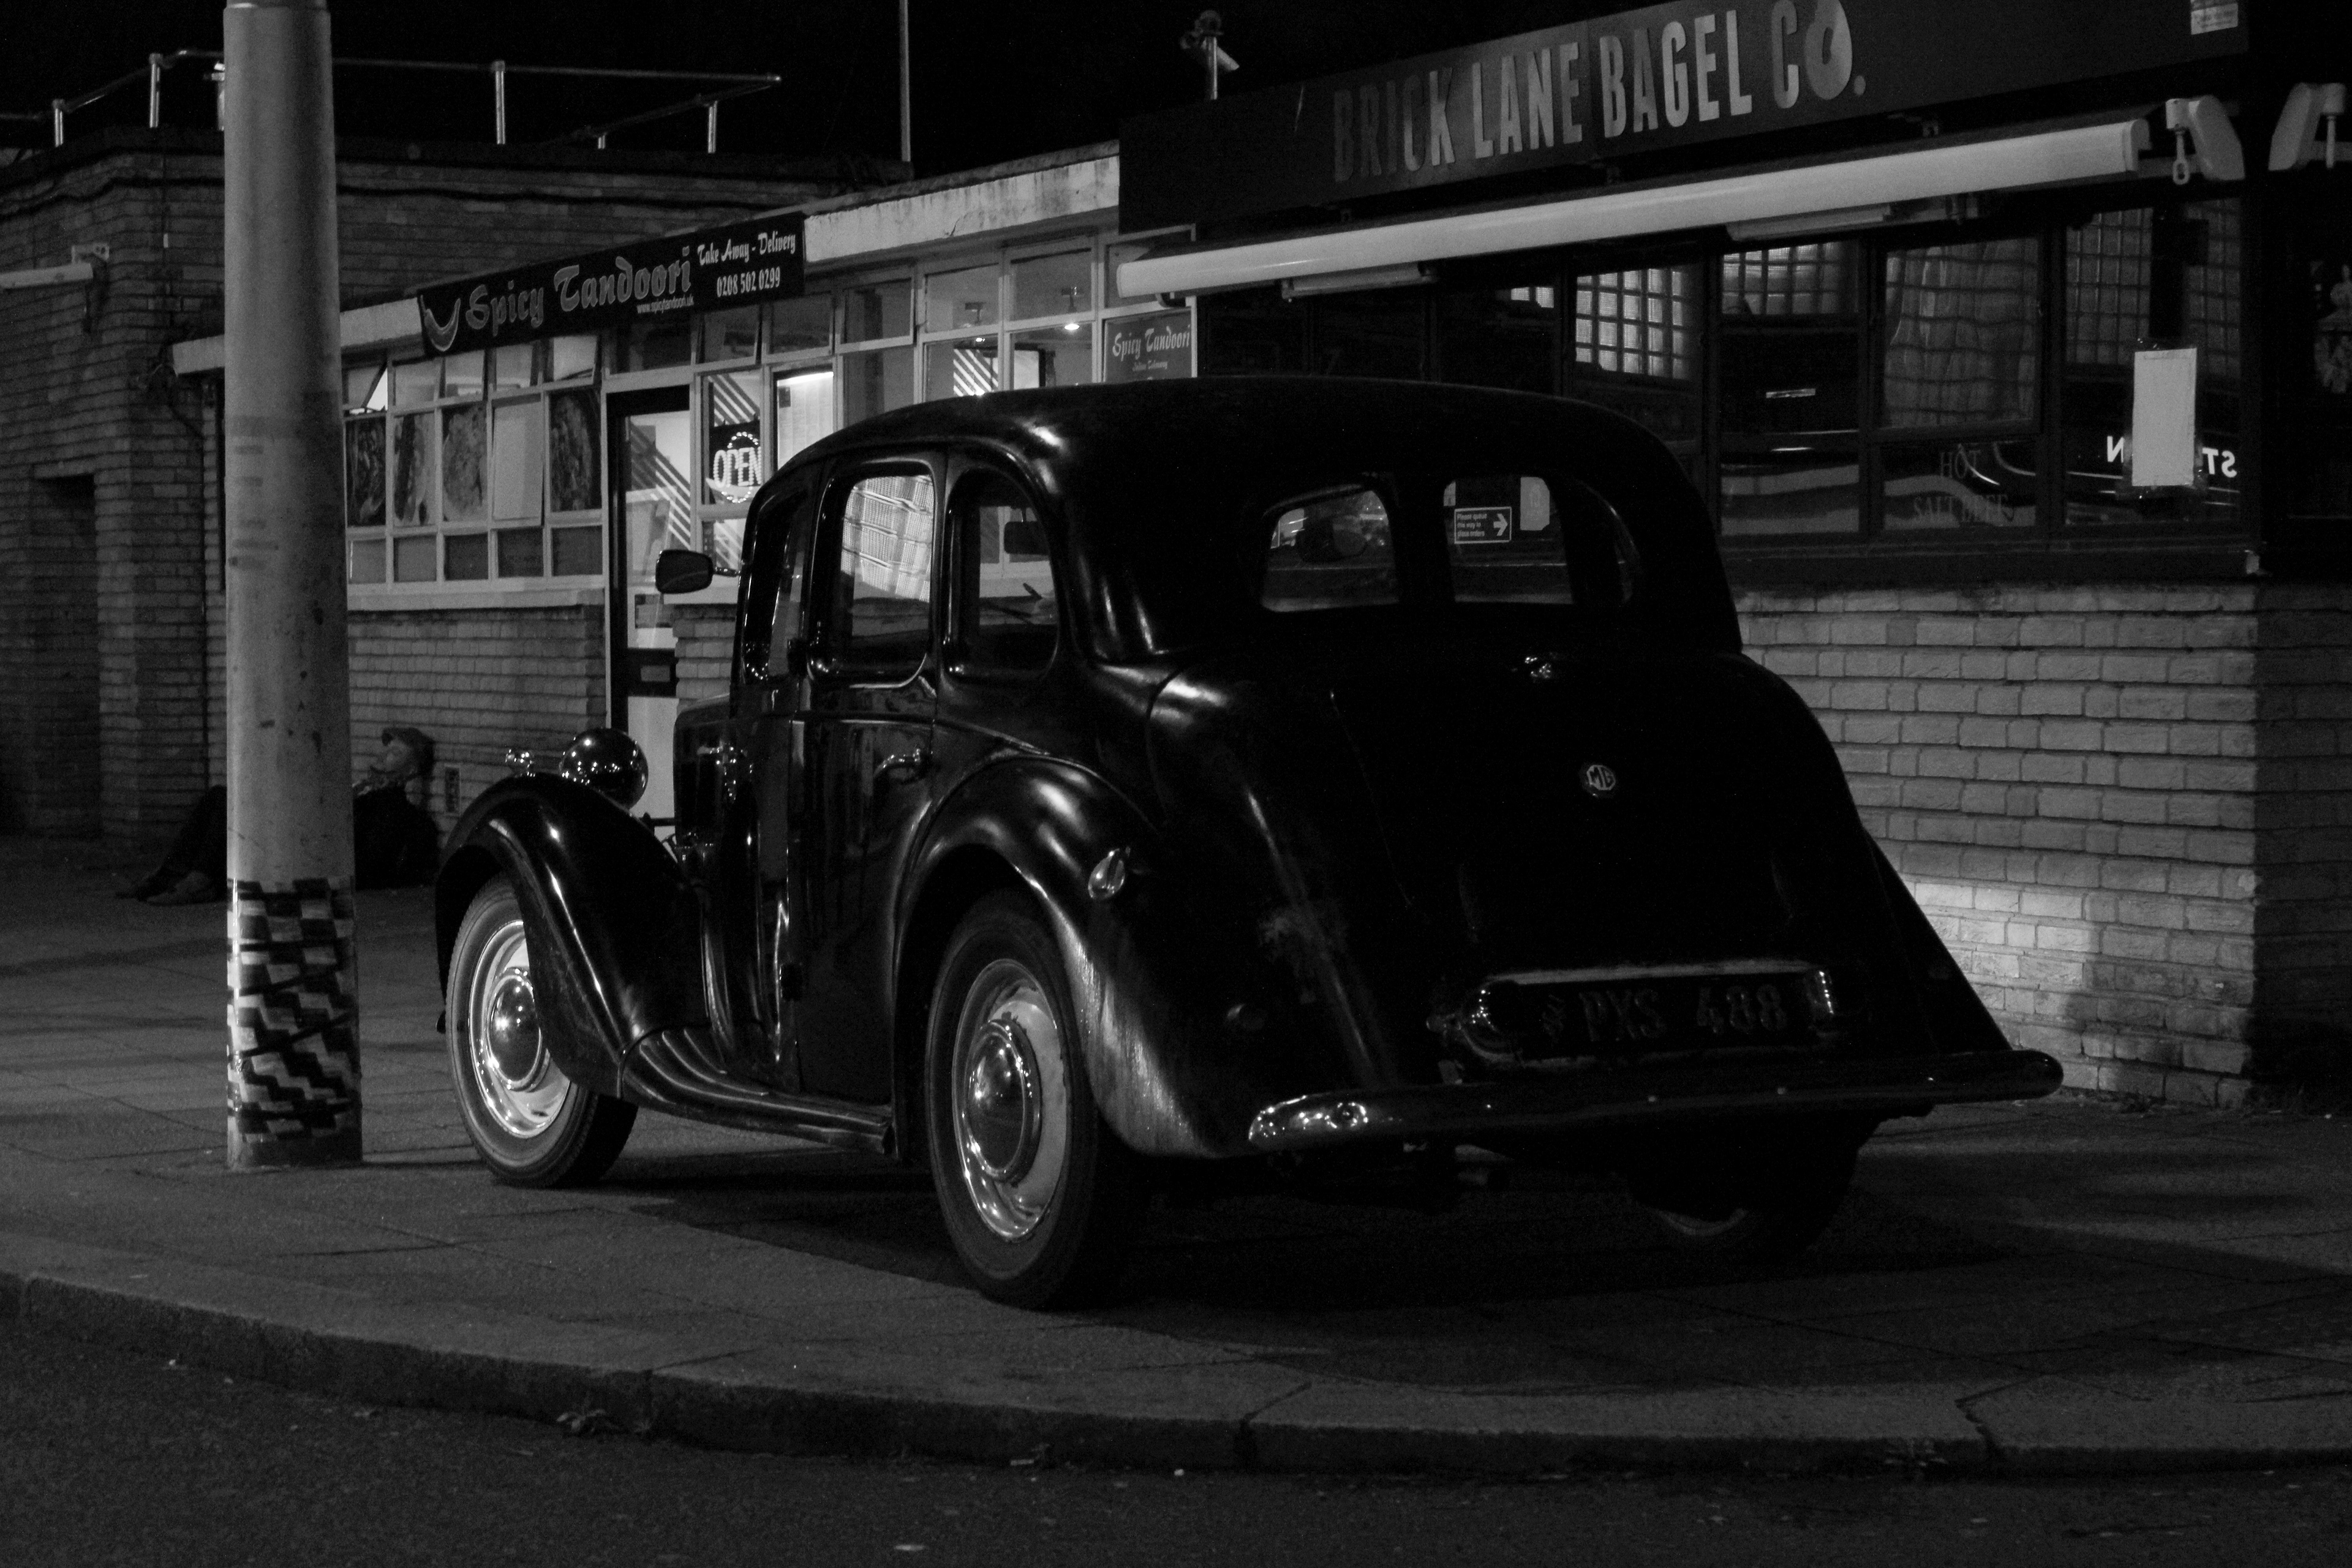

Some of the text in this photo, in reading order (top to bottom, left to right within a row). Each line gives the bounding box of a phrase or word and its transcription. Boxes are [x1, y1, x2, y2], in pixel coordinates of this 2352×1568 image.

[1333, 67, 1456, 183] BRICK
[1472, 42, 1583, 160] LANE
[1599, 9, 1753, 139] BAGEL
[697, 242, 719, 266] Take
[721, 238, 749, 263] Away
[758, 230, 796, 255] Delivery
[466, 245, 692, 337] Spicy Tandoori
[717, 266, 780, 298] 0208 502 0299
[1112, 324, 1191, 362] Spicy Tandoori
[713, 447, 762, 488] OPEN
[1939, 450, 1981, 479] HOT
[1913, 496, 1954, 523] SALT
